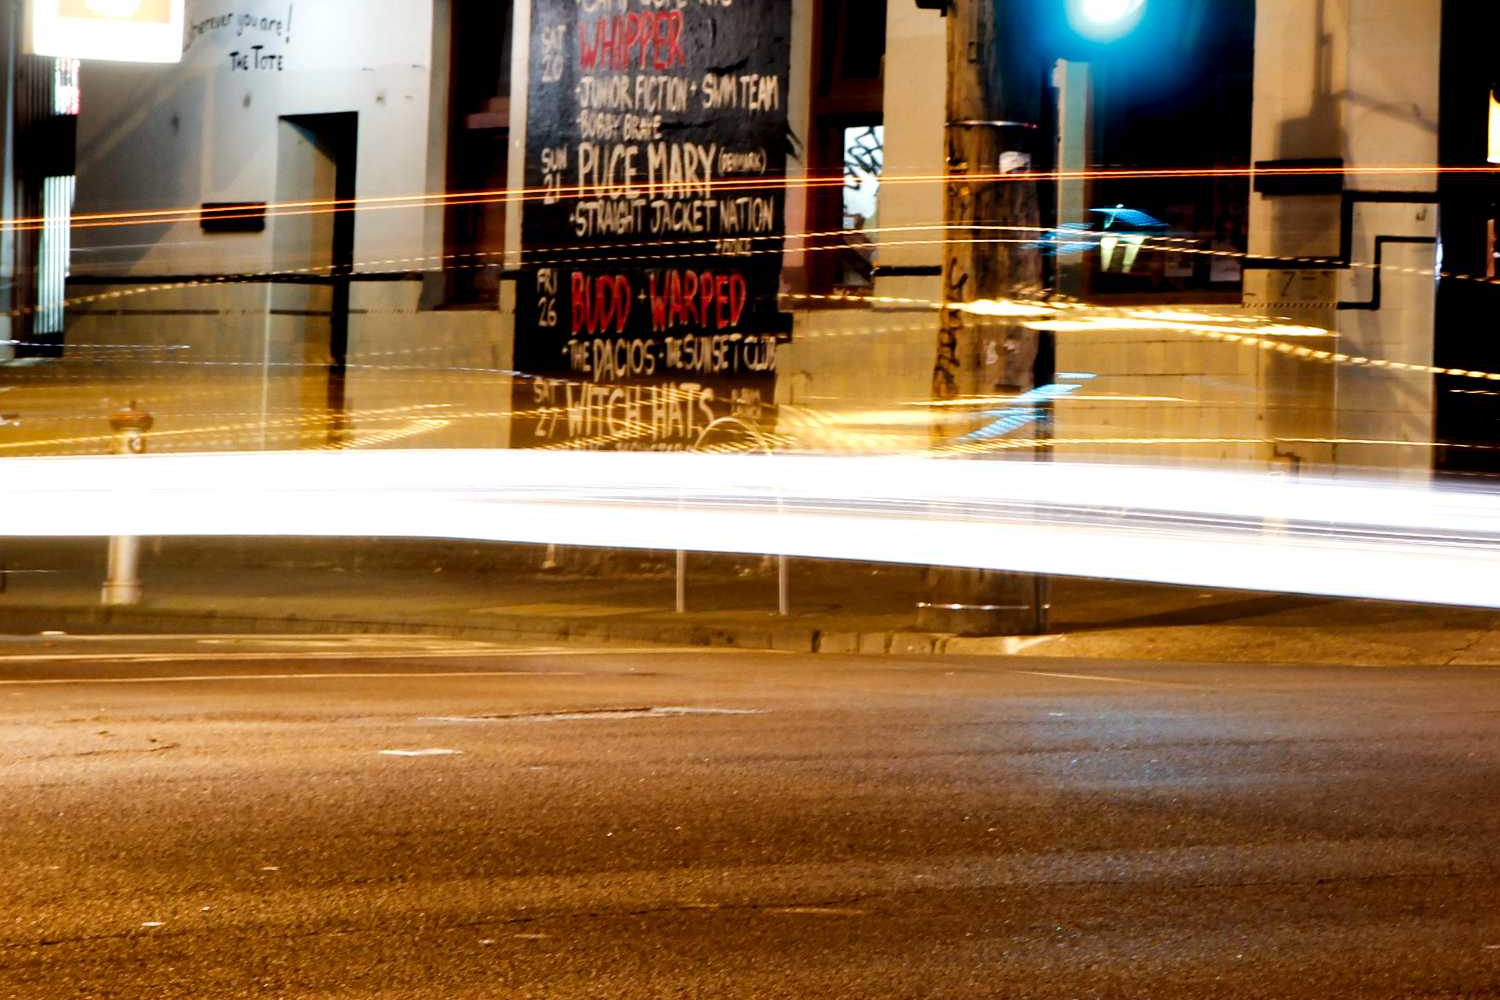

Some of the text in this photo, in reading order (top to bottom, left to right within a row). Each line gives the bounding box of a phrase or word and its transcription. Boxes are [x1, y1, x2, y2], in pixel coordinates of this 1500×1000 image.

[578, 10, 685, 72] WHIPPER
[740, 74, 780, 111] TEAM
[577, 144, 639, 199] PUCE
[646, 142, 717, 200] MARY
[651, 200, 717, 235] JACKET
[719, 196, 774, 233] NATION
[538, 296, 557, 327] 26
[571, 271, 632, 336] BUDD
[650, 269, 746, 331] WARPED
[566, 382, 641, 438] WITCH
